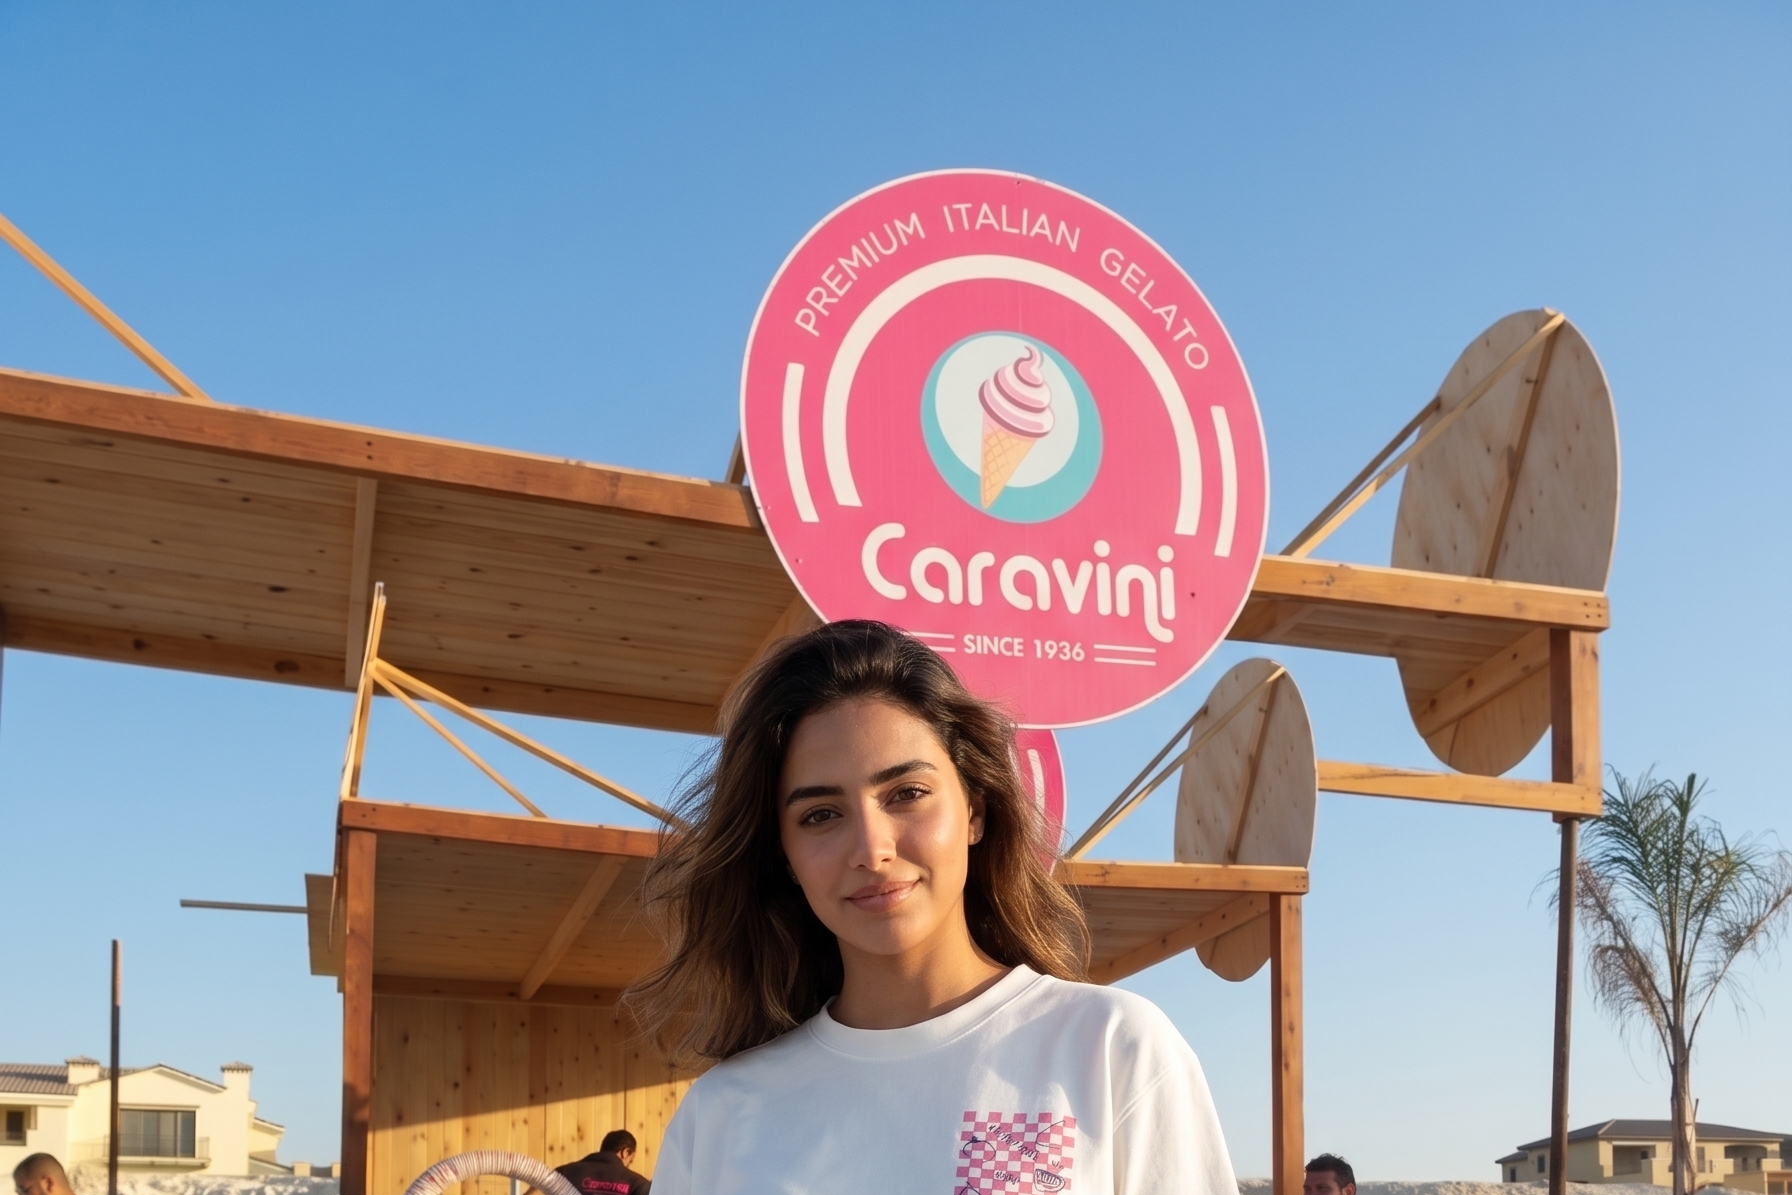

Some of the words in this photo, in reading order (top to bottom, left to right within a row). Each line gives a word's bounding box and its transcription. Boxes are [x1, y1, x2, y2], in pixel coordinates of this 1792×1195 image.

[794, 212, 926, 338] PREMIUM
[943, 203, 1080, 252] ITALIAN
[1100, 248, 1209, 370] GELATO
[861, 522, 1176, 644] Caravini
[963, 633, 1024, 657] SINCE
[1033, 639, 1085, 662] 1936
